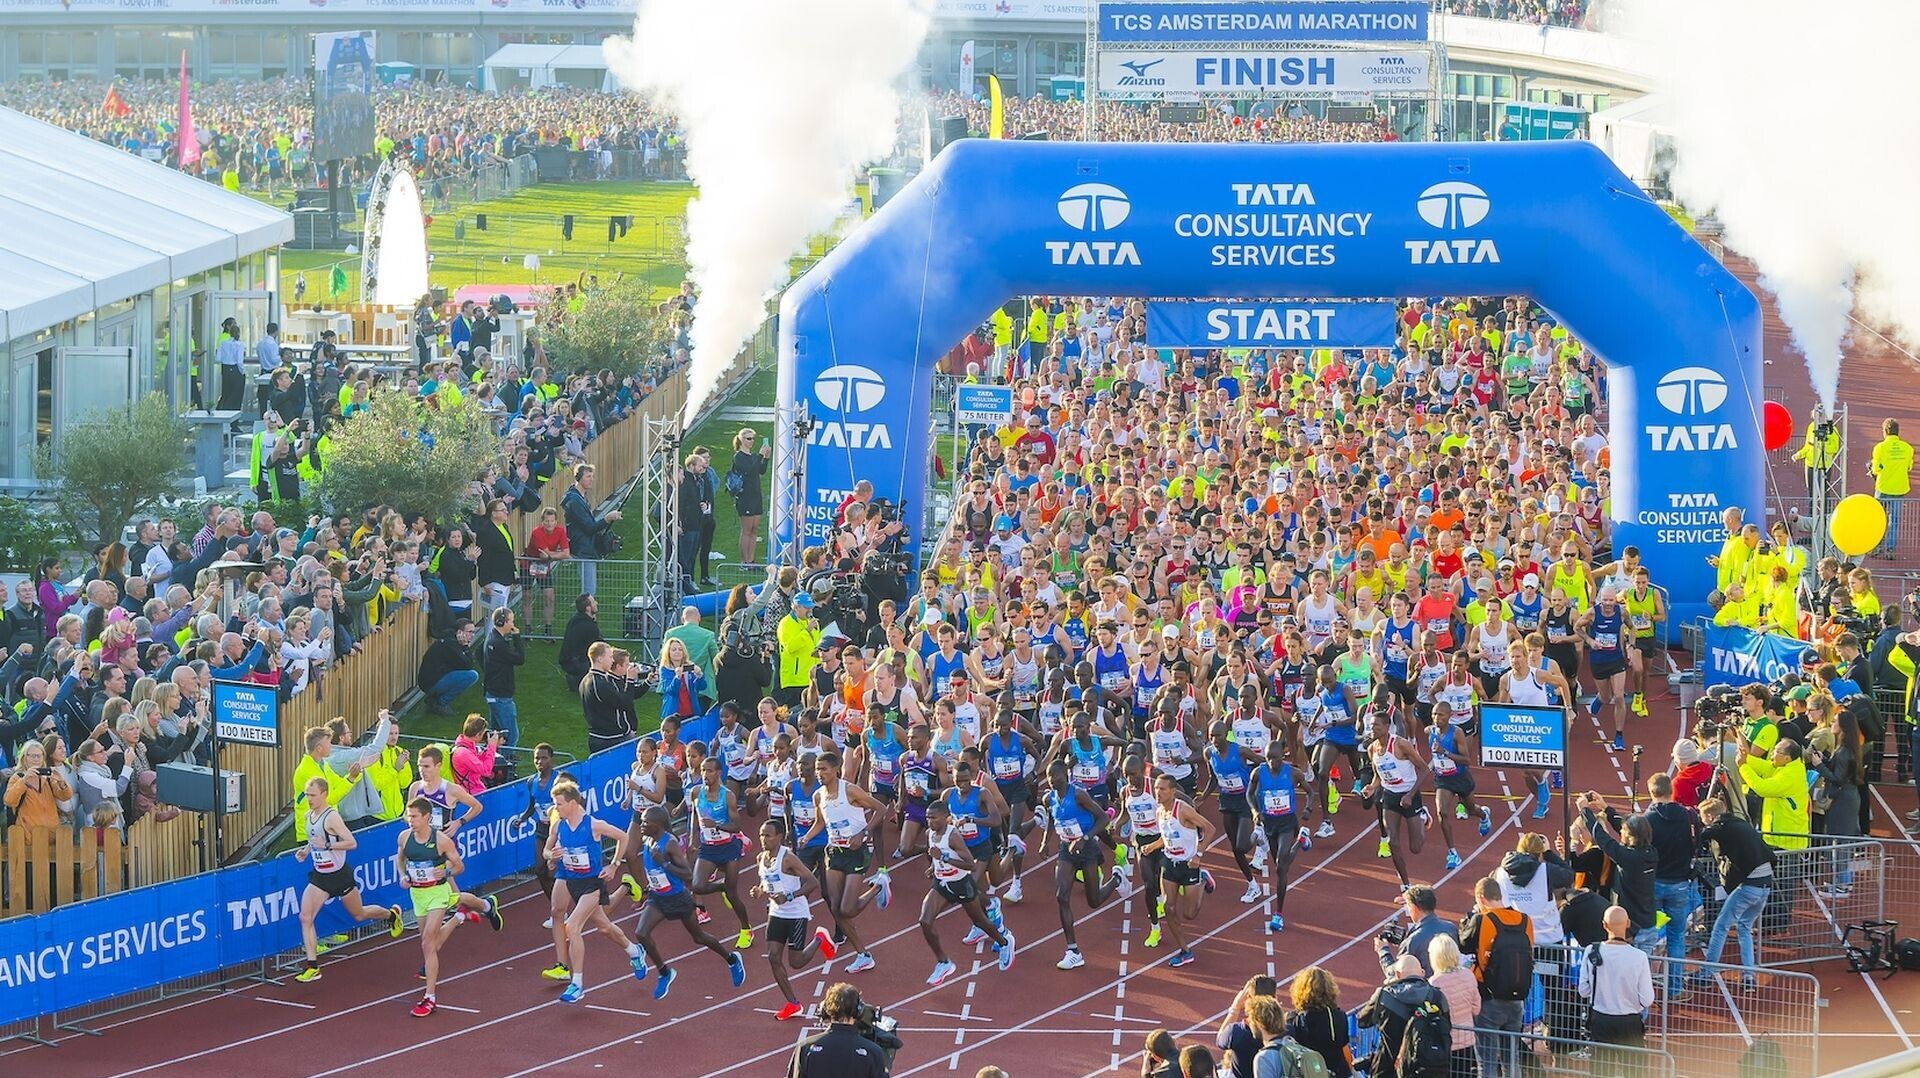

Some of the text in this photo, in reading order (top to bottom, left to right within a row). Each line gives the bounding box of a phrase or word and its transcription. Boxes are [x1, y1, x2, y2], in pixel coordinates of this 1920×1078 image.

[1111, 14, 1417, 31] TCS AMSTERDAM MARATHON
[1379, 57, 1404, 66] TATA
[1195, 57, 1335, 86] FINISH
[1361, 66, 1422, 75] CONSULTANCY
[1117, 76, 1165, 86] MIZUNO
[1372, 75, 1411, 84] SERVICES
[1231, 183, 1316, 206] TATA
[1174, 212, 1373, 238] CONSULTANCY
[1045, 241, 1142, 266] TATA
[1210, 244, 1336, 267] SERVICES
[1405, 239, 1500, 264] TATA
[1206, 308, 1336, 341] START
[965, 396, 1005, 404] CONSULTANCY
[964, 411, 1005, 421] 75 METER
[1645, 424, 1738, 452] TATA
[1668, 493, 1719, 507] TATA
[1638, 508, 1746, 526] CONSULTAN
[1657, 528, 1729, 544] SERVICES
[236, 691, 256, 701] TATA
[223, 699, 269, 713] CONSULTANCY
[231, 709, 261, 722] SERVICES
[1509, 714, 1535, 724] TATA
[220, 723, 274, 742] 100 METER
[1491, 723, 1552, 735] CONSULTANCY
[1503, 734, 1542, 745] SERVICES
[1487, 749, 1558, 765] 100 METER
[228, 887, 300, 932] TATA
[82, 909, 207, 970] SERVICES
